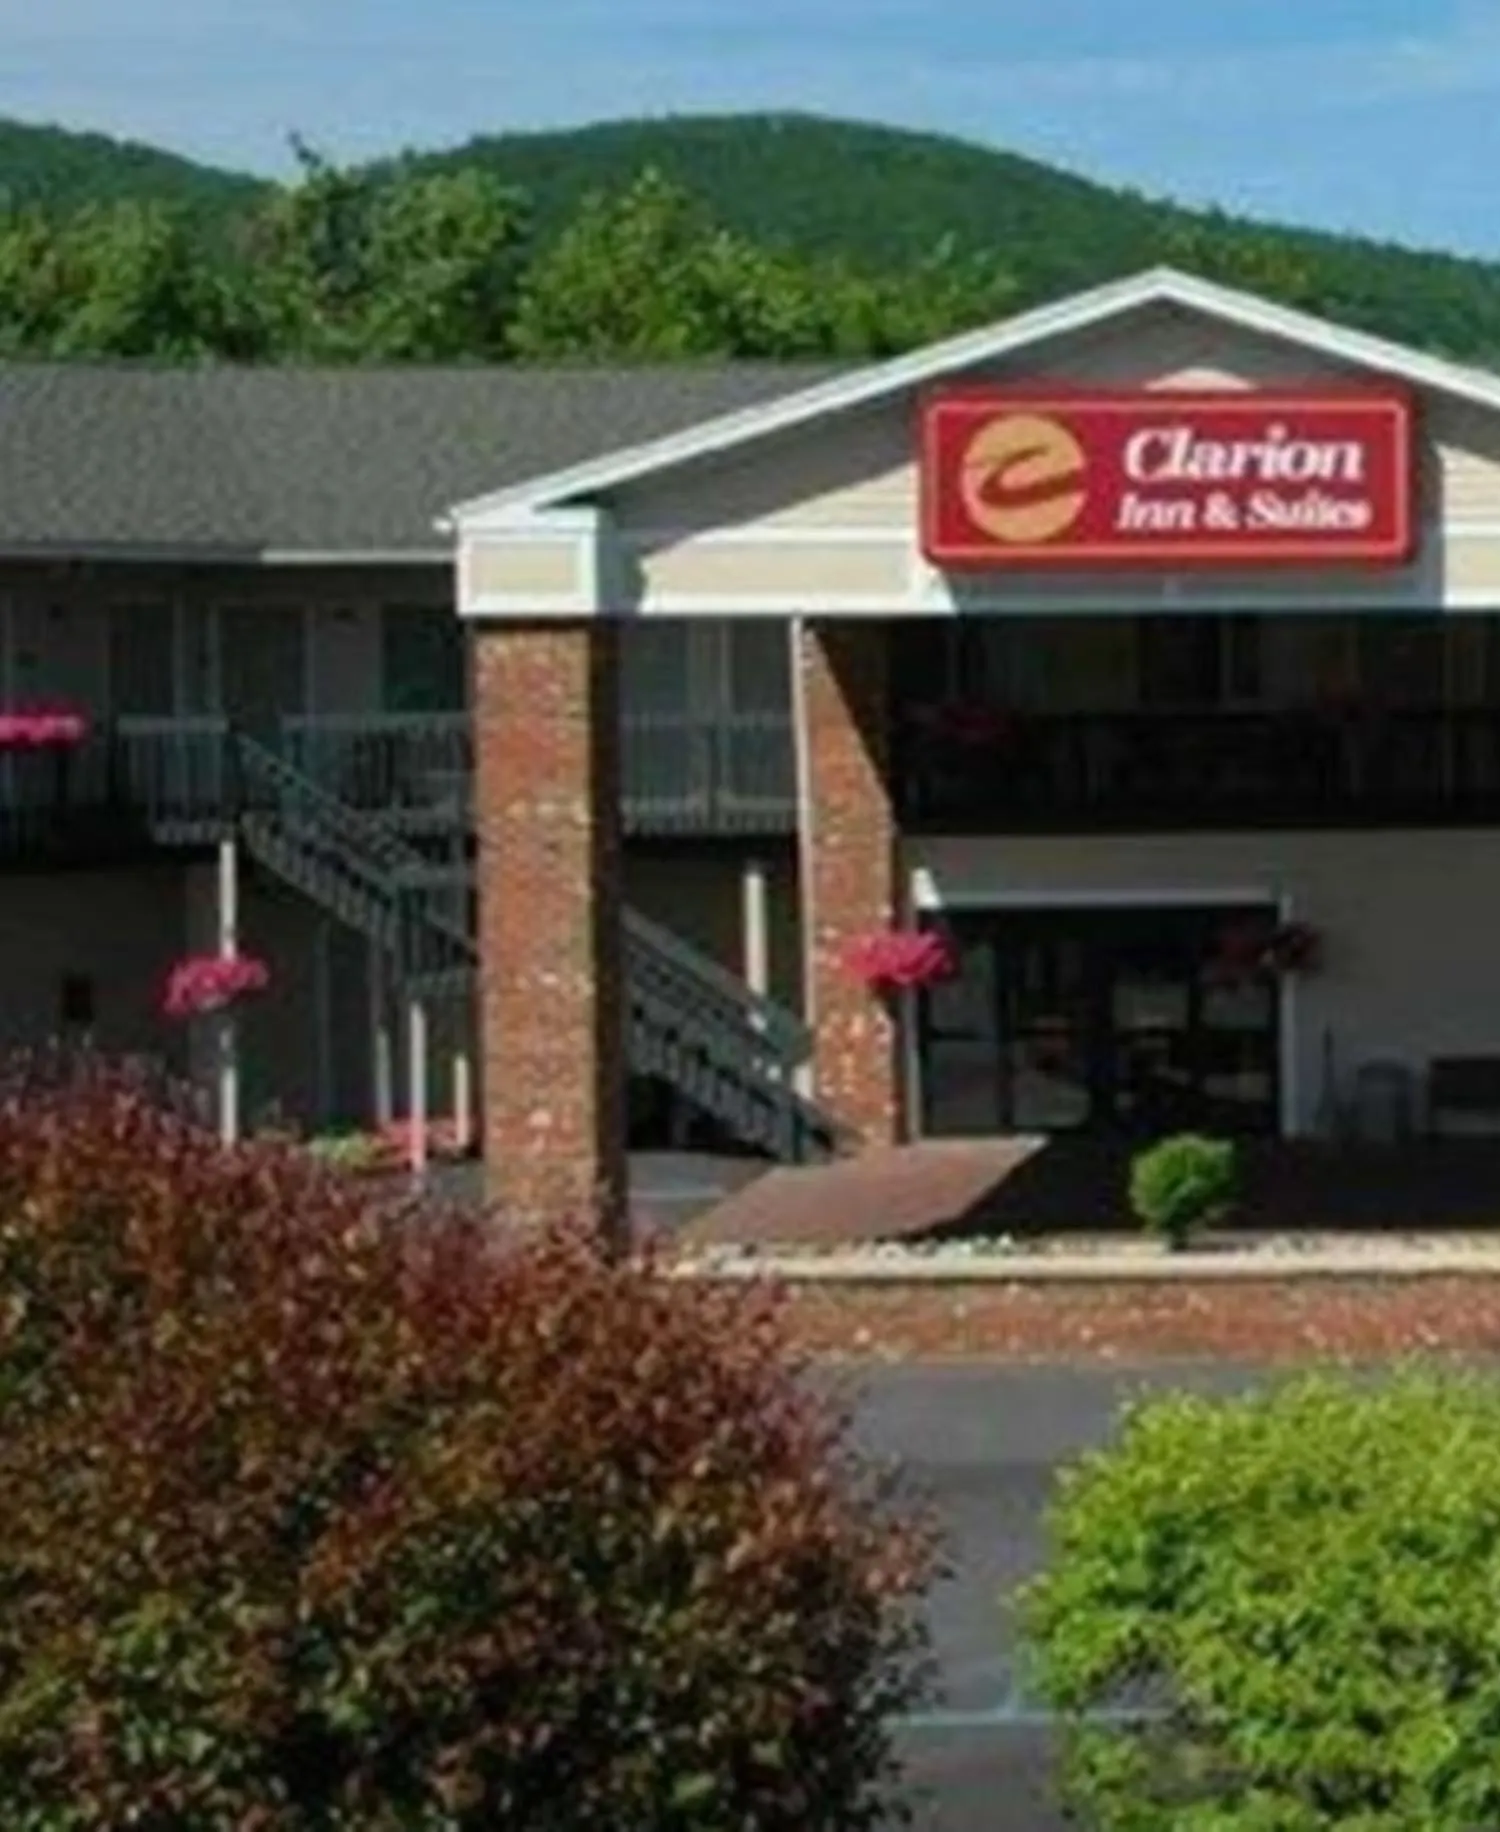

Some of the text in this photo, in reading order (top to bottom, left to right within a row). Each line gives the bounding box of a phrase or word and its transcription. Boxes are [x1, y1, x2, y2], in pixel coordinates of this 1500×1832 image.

[1124, 424, 1364, 482] Clarion
[1117, 489, 1372, 531] Inn & Suites
